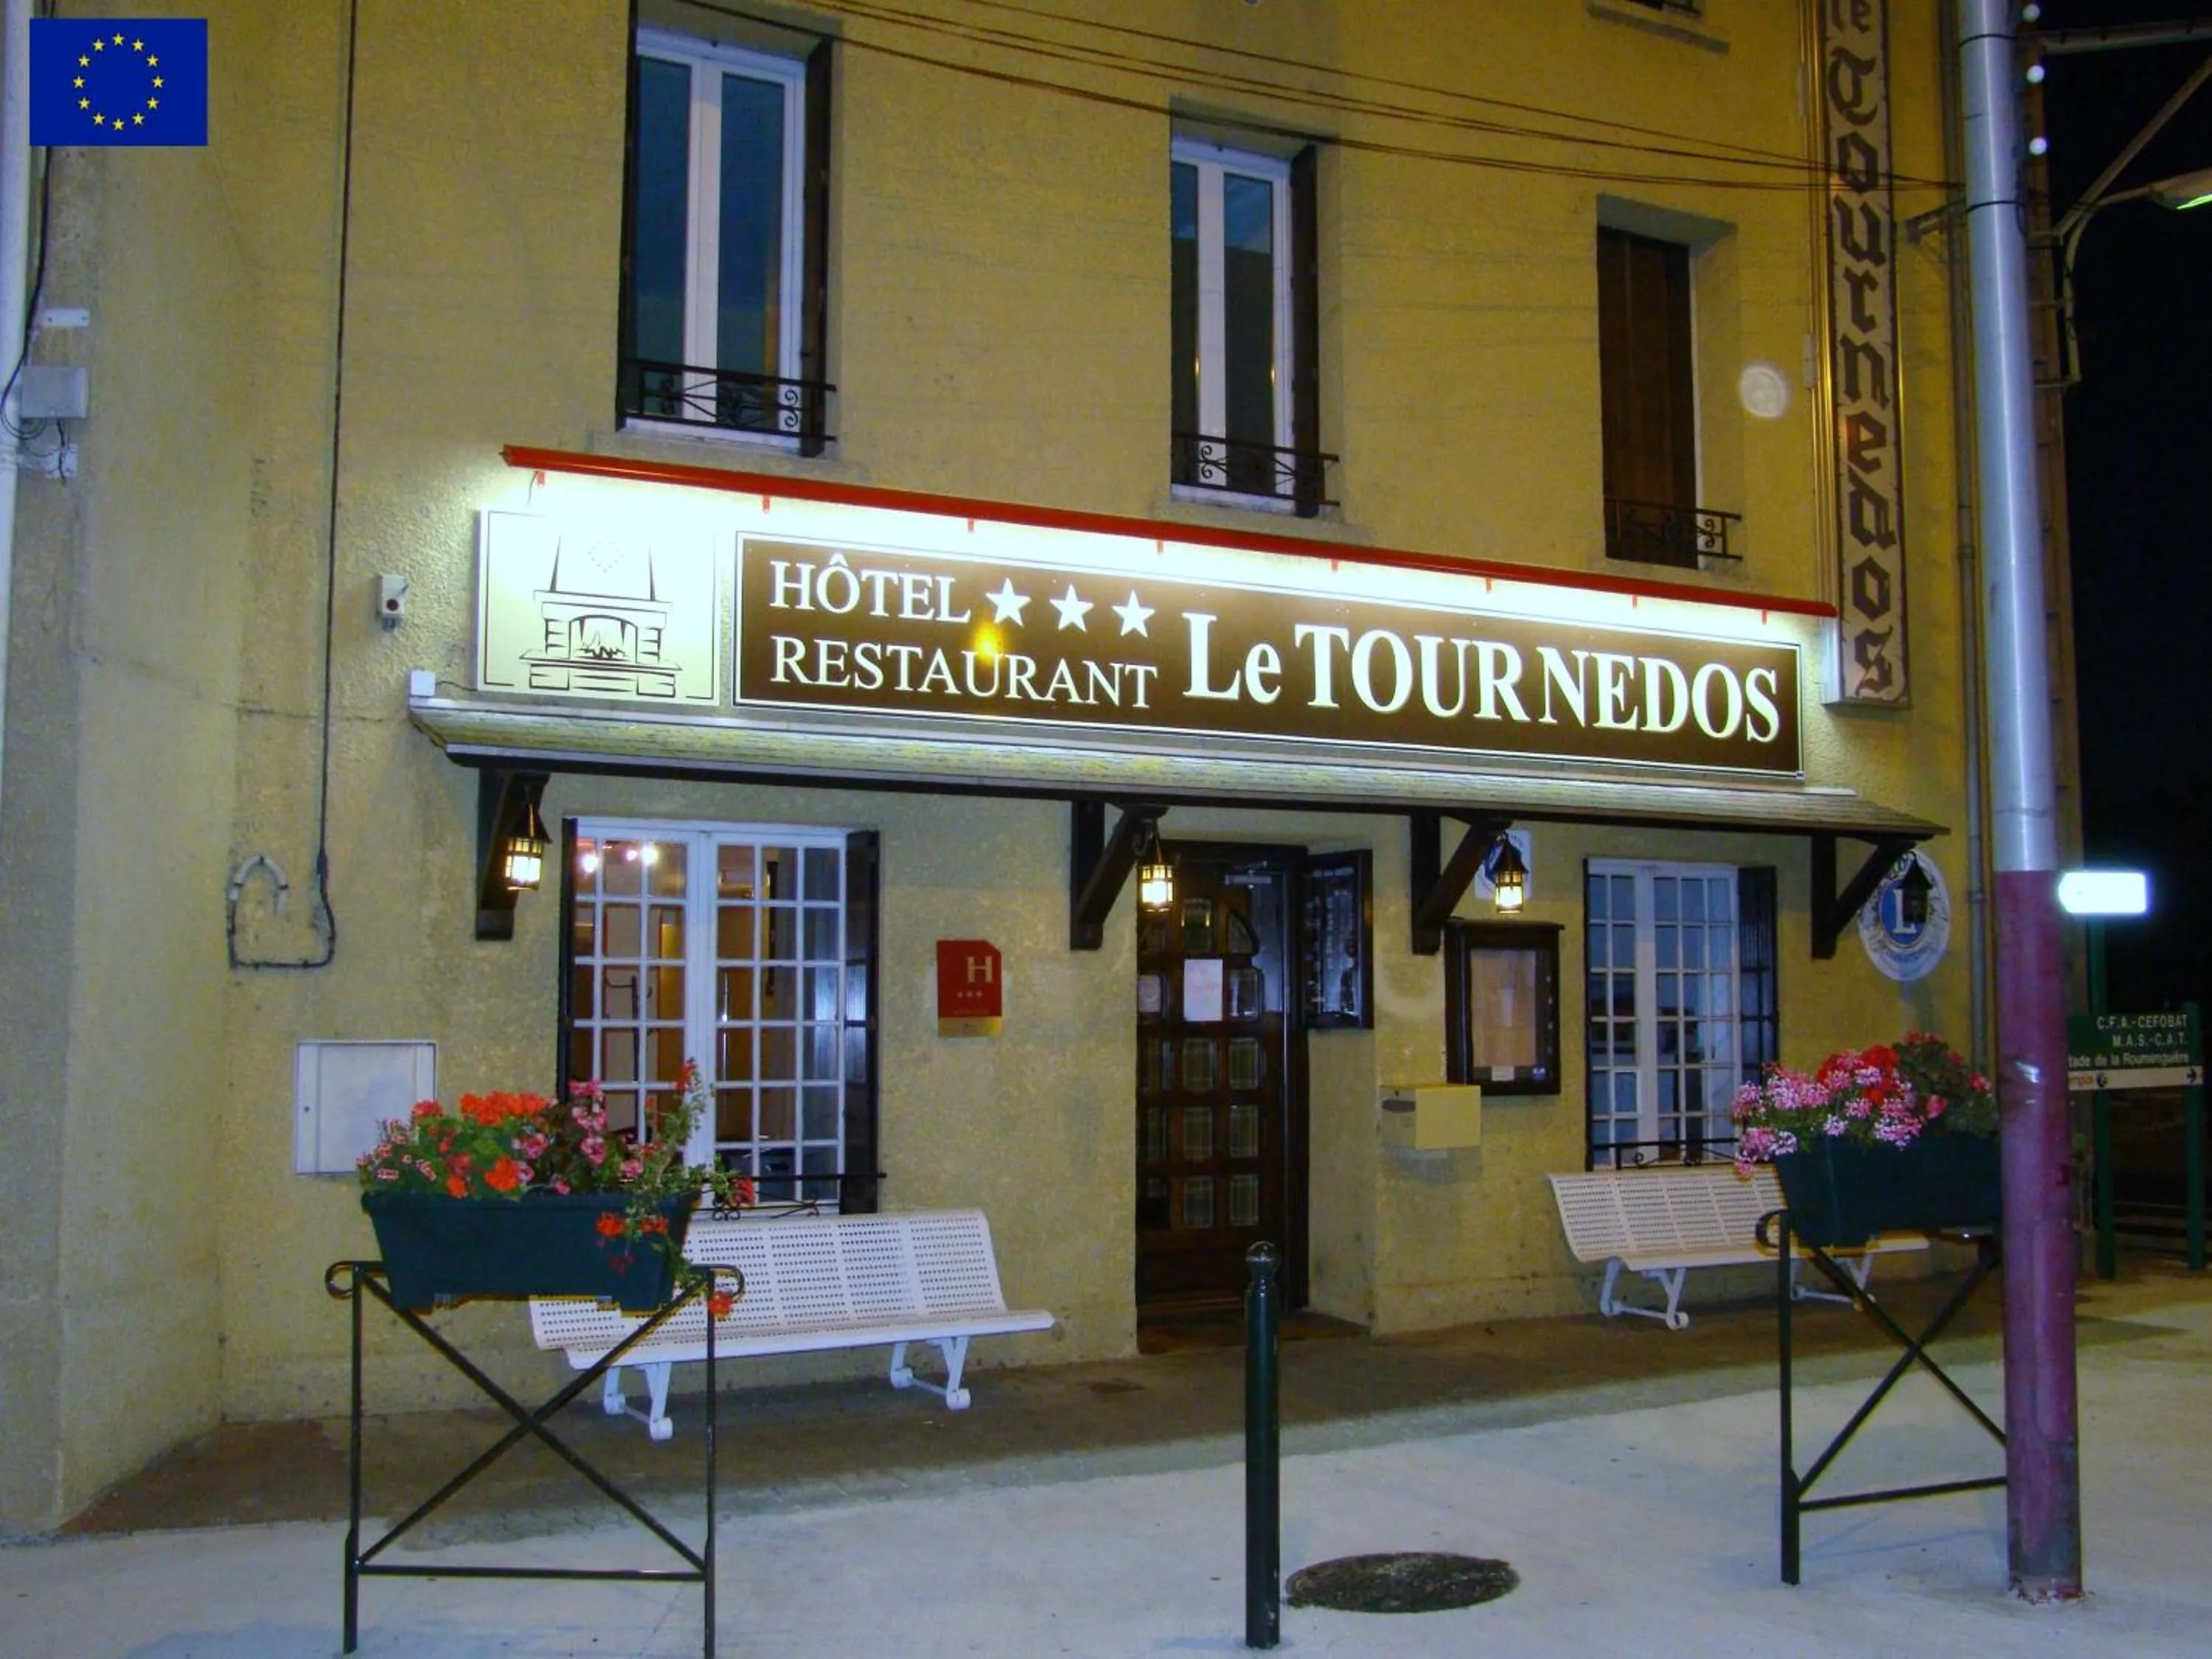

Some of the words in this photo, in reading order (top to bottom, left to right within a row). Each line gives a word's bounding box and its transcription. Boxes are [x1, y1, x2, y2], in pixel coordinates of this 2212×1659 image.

[1828, 46, 1897, 696] Tournedos
[769, 552, 971, 624] HÔTEL
[769, 636, 1158, 709] RESTAURANT
[1182, 612, 1282, 704] Le
[1295, 624, 1781, 742] TOURNEDOS
[967, 956, 993, 984] H
[2068, 1053, 2091, 1067] tade
[2095, 1054, 2107, 1066] de
[2110, 1052, 2120, 1065] la
